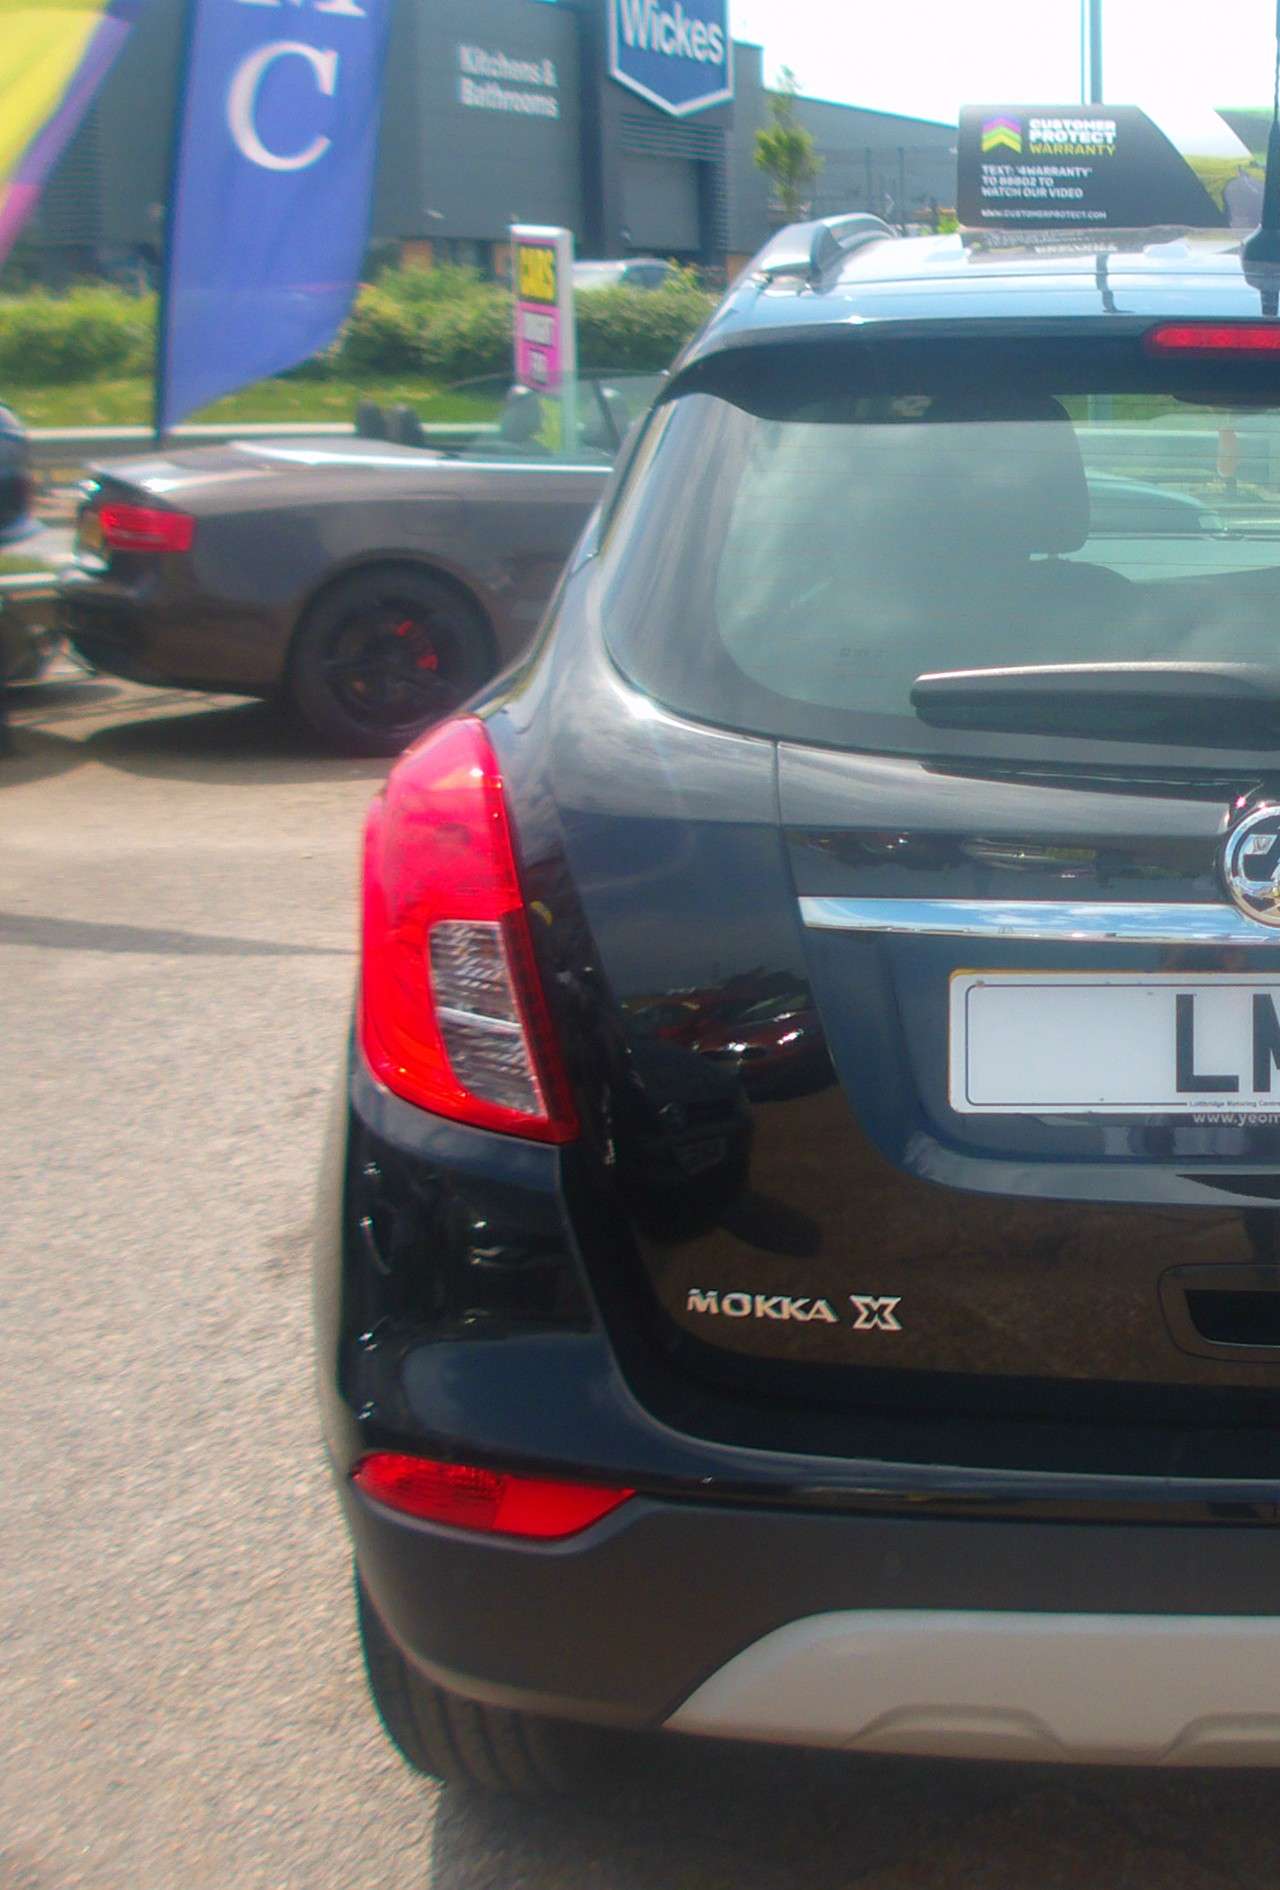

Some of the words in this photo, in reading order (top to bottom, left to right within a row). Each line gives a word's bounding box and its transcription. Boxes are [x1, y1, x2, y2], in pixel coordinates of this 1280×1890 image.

[619, 0, 725, 65] Wickes
[459, 46, 540, 83] Kitchens
[460, 77, 559, 118] Bathrooms
[1029, 118, 1117, 131] CUSTOMER
[1029, 130, 1117, 144] PROTECT
[1029, 143, 1117, 156] WARRANTY
[982, 176, 997, 186] TO
[1038, 177, 1054, 187] TO
[981, 186, 1021, 198] WATCH
[1023, 187, 1048, 198] OUR
[1049, 187, 1083, 199] VIDEO
[687, 1288, 839, 1323] MOKKA
[849, 1294, 902, 1331] X
